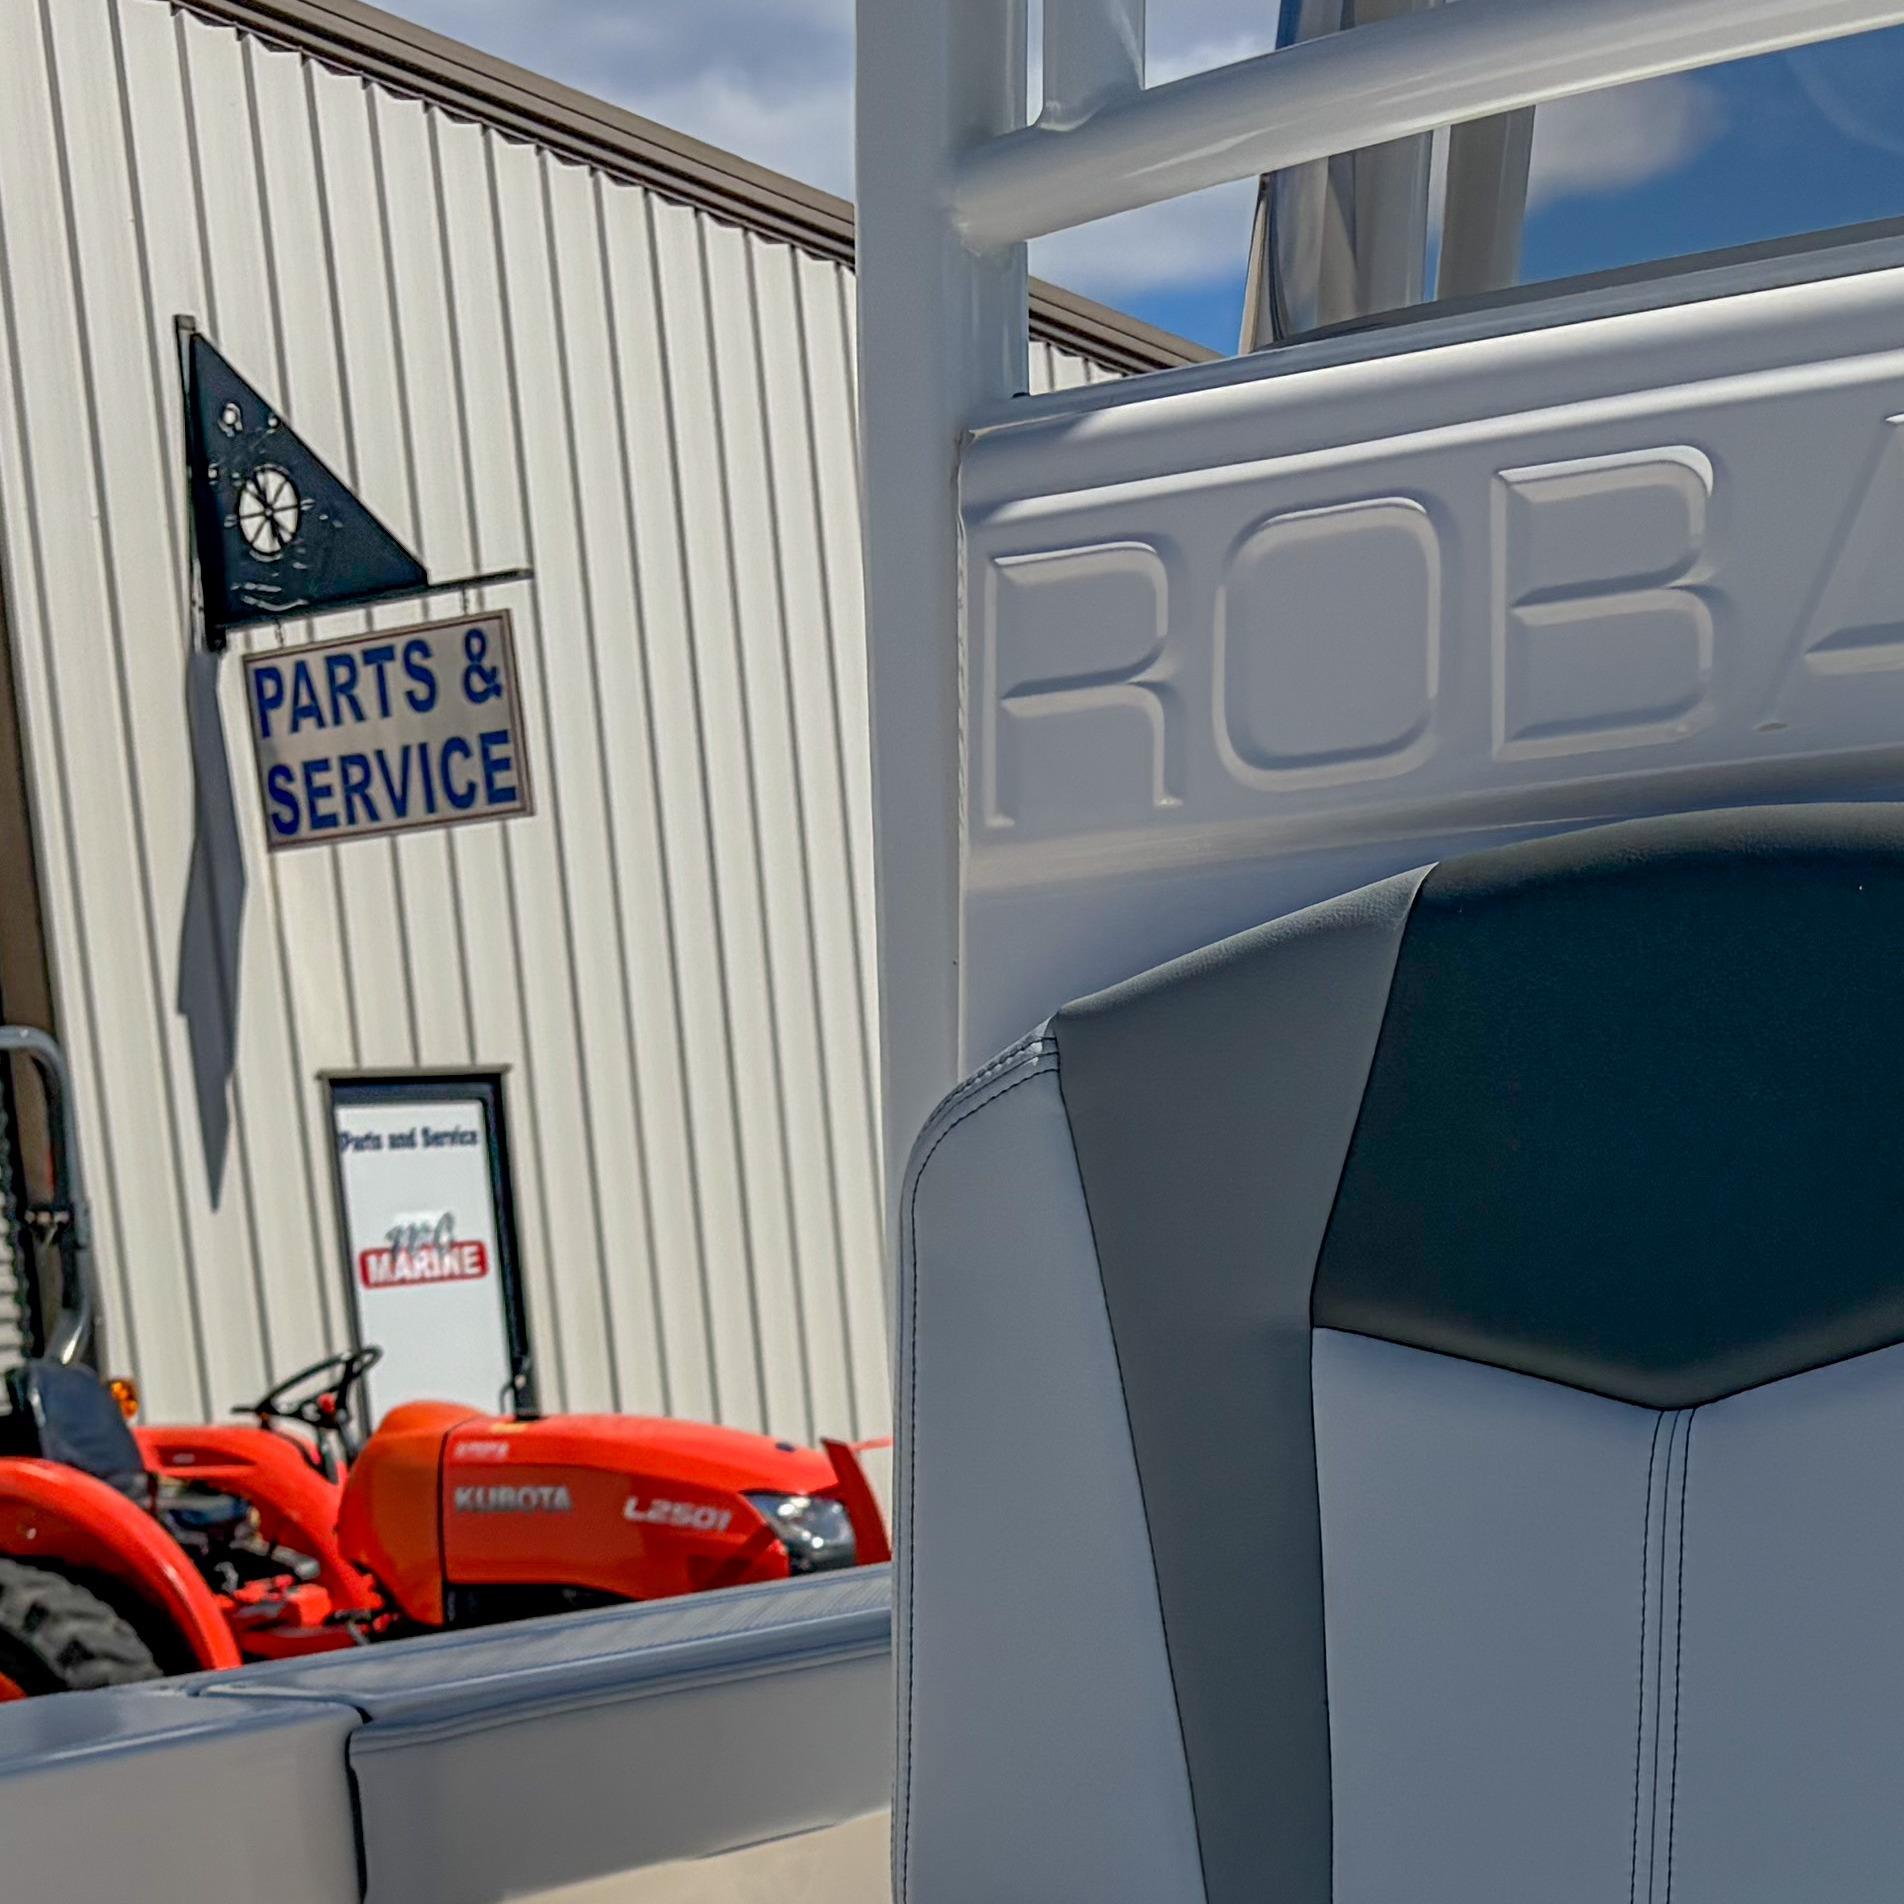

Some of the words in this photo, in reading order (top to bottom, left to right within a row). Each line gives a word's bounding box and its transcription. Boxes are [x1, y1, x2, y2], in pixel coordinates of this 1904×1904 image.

[254, 640, 436, 738] PARTS
[463, 627, 503, 704] &
[267, 729, 518, 836] SERVICE
[389, 1127, 417, 1148] and
[367, 1245, 481, 1284] MARINE
[454, 1486, 570, 1512] KUBOTA
[623, 1496, 732, 1531] L2501
